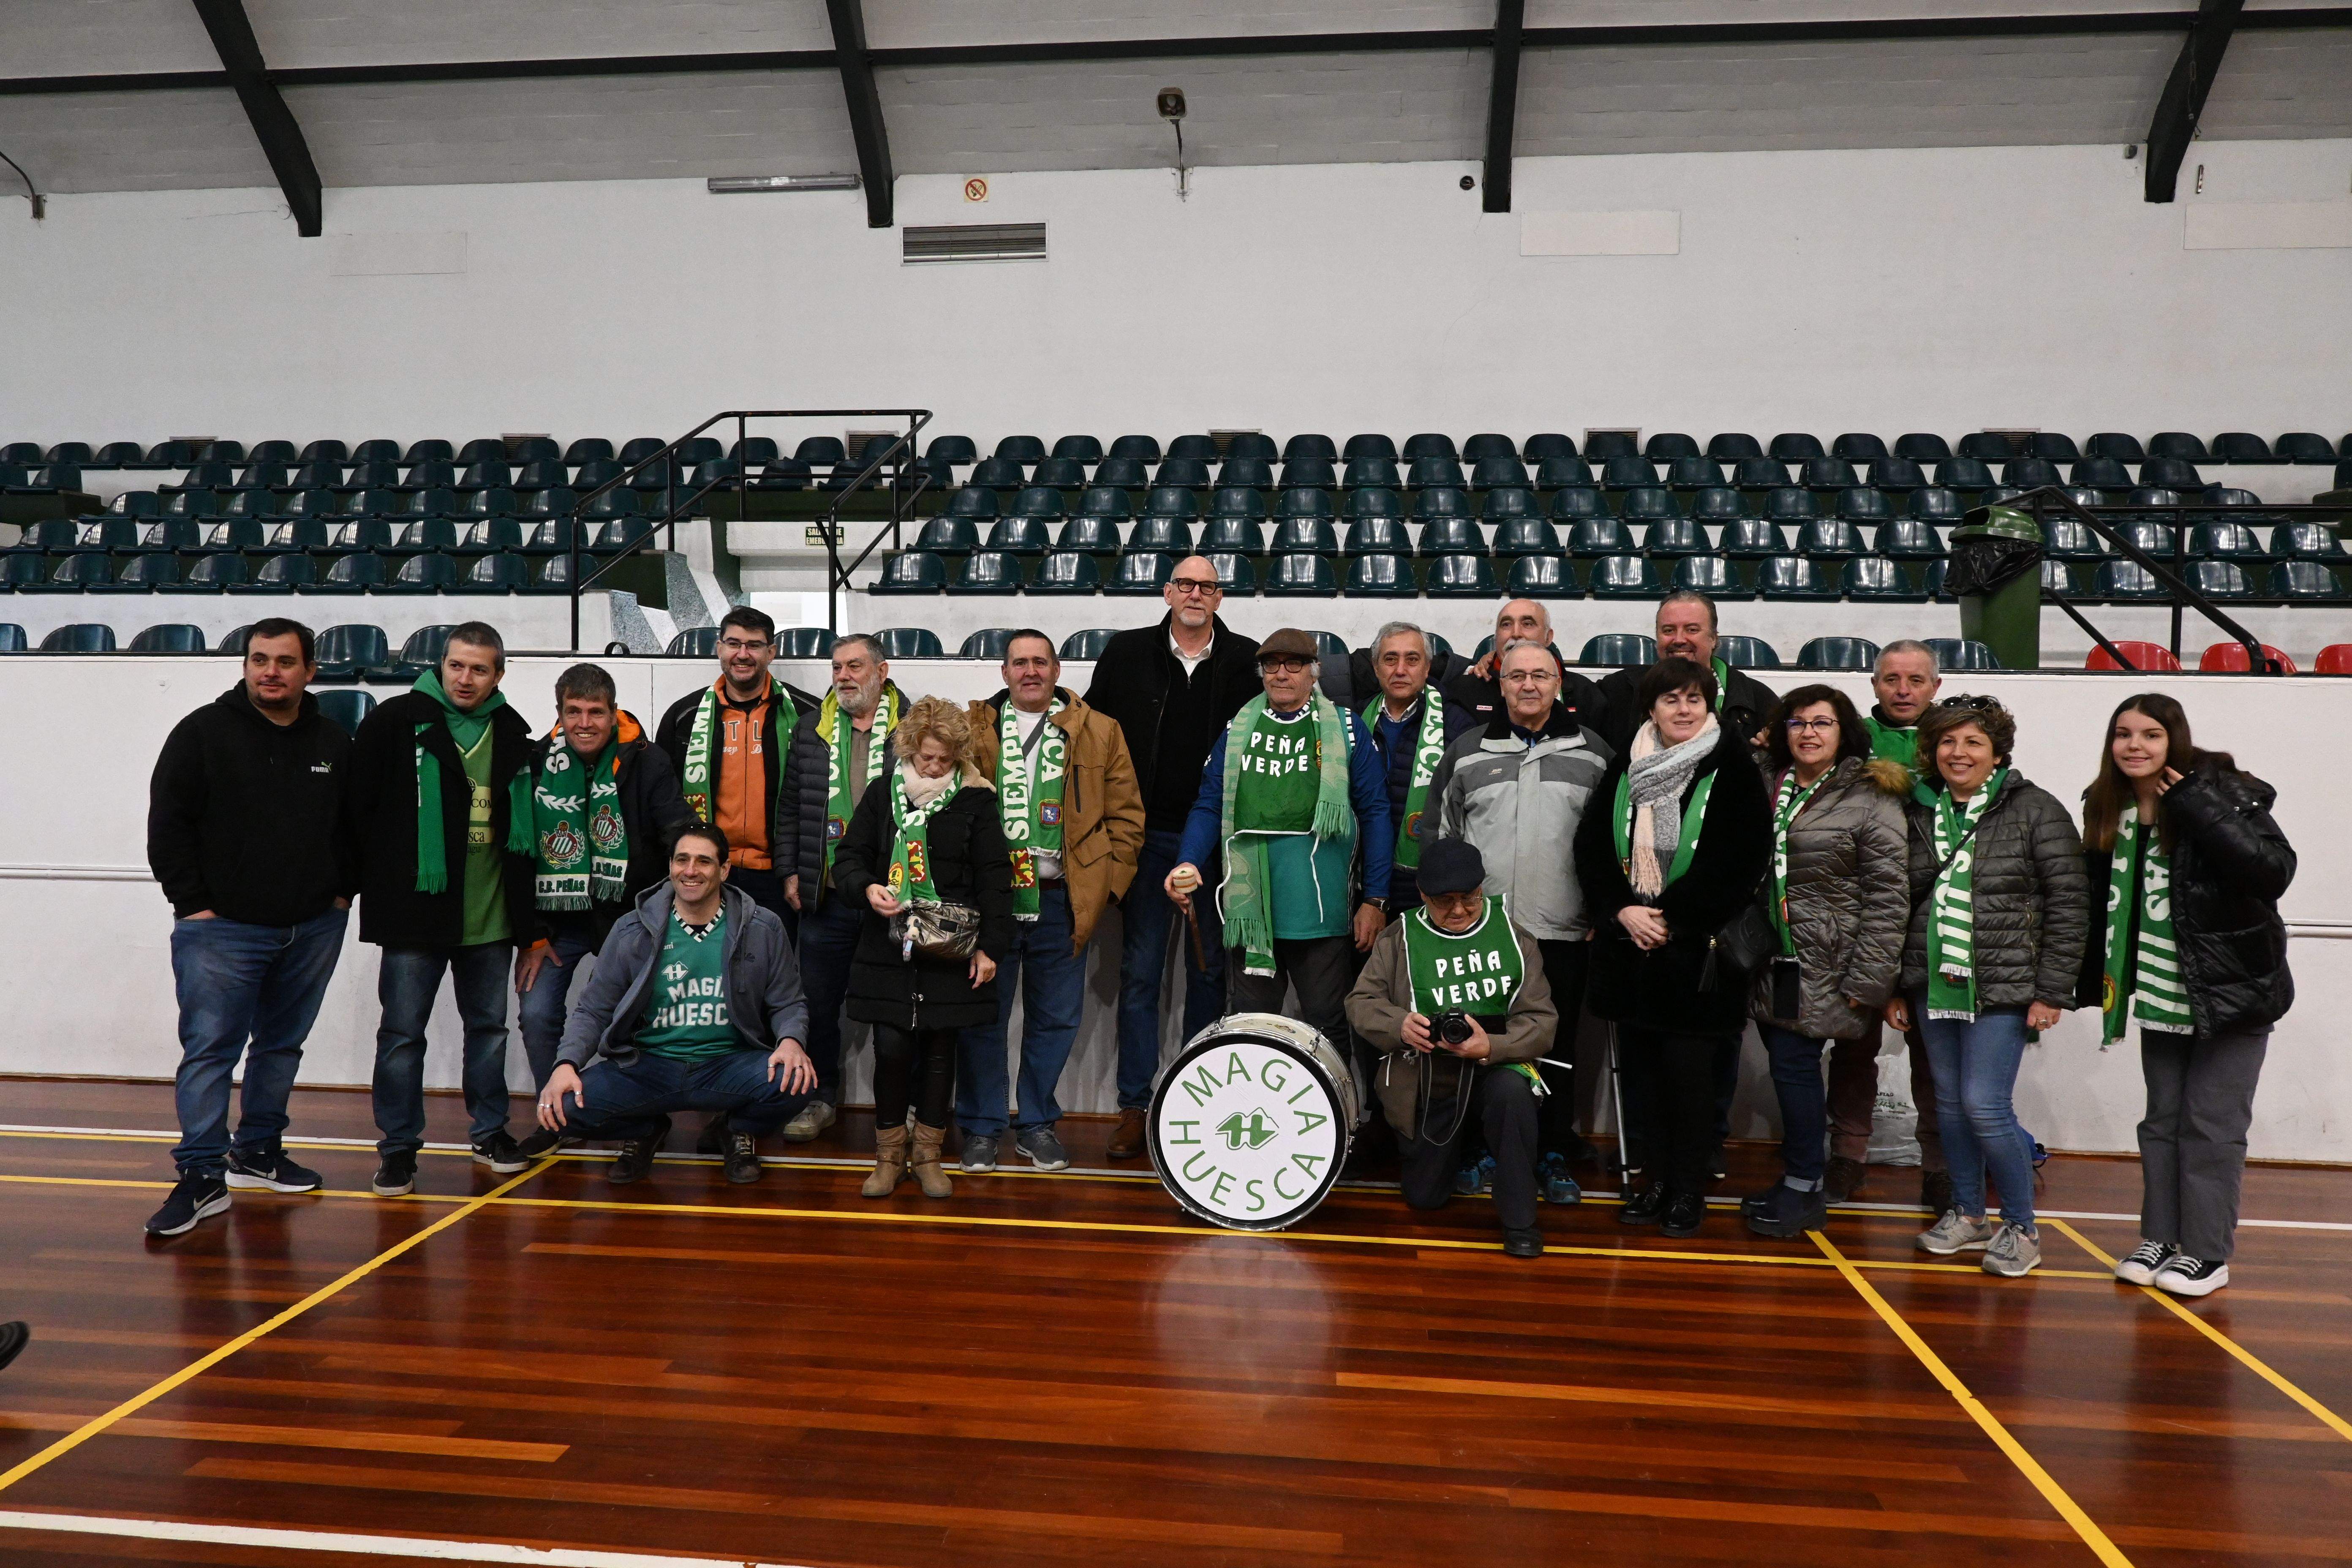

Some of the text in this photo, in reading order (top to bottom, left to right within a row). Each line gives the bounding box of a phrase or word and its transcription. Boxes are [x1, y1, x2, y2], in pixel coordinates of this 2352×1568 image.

[1251, 732, 1305, 754] PEÑA
[1242, 754, 1307, 777] VERDE
[556, 878, 585, 892] PEÑAS
[1436, 949, 1501, 978] PEÑA
[667, 976, 724, 1003] MAGI
[653, 1003, 732, 1028] HUESC
[1181, 1052, 1327, 1136] MAGIA
[1169, 1121, 1326, 1211] HUESCA
